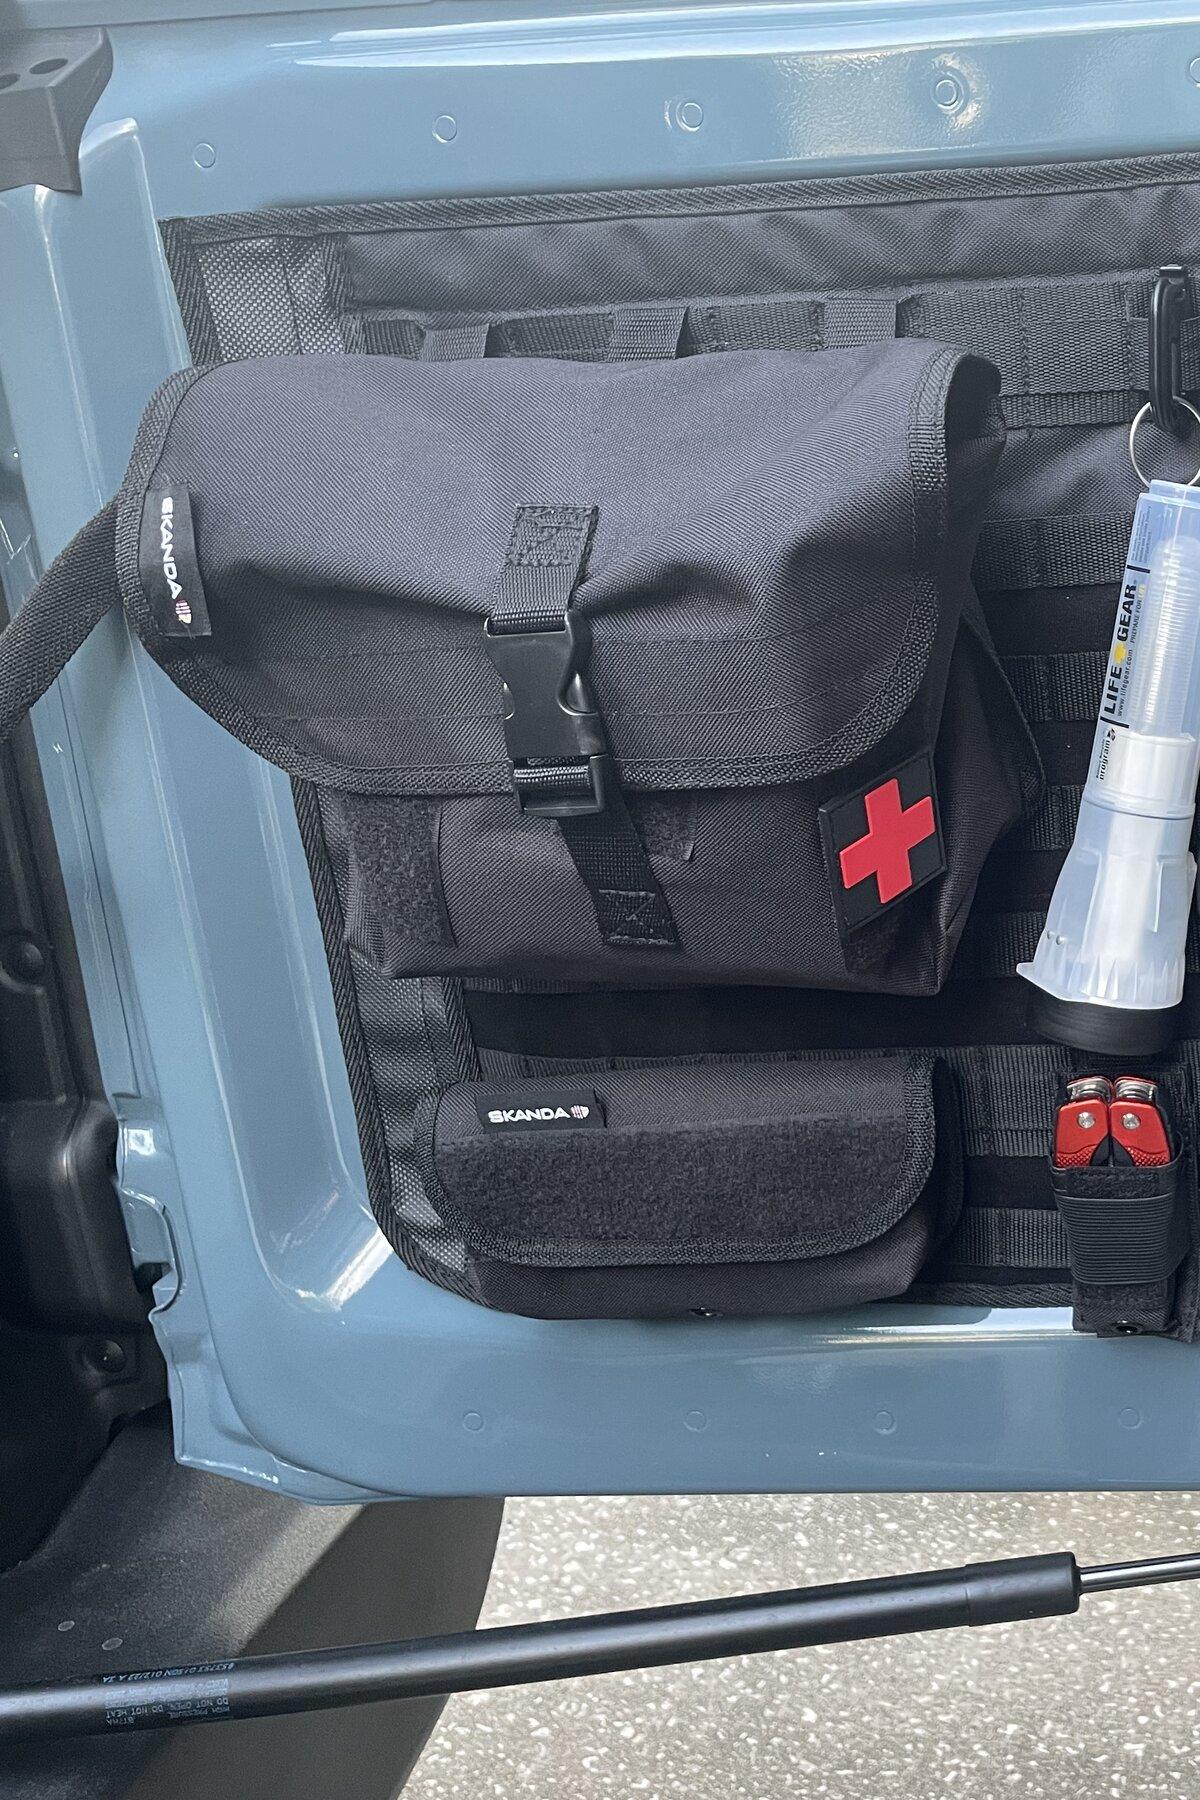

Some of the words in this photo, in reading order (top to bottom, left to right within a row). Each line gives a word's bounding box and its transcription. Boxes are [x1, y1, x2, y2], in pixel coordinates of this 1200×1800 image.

[160, 496, 183, 600] SKANDA
[1104, 665, 1123, 714] LIFE
[1116, 584, 1137, 641] GEAR
[1118, 649, 1133, 717] www.lifegear.com
[487, 1105, 571, 1124] SKANDA
